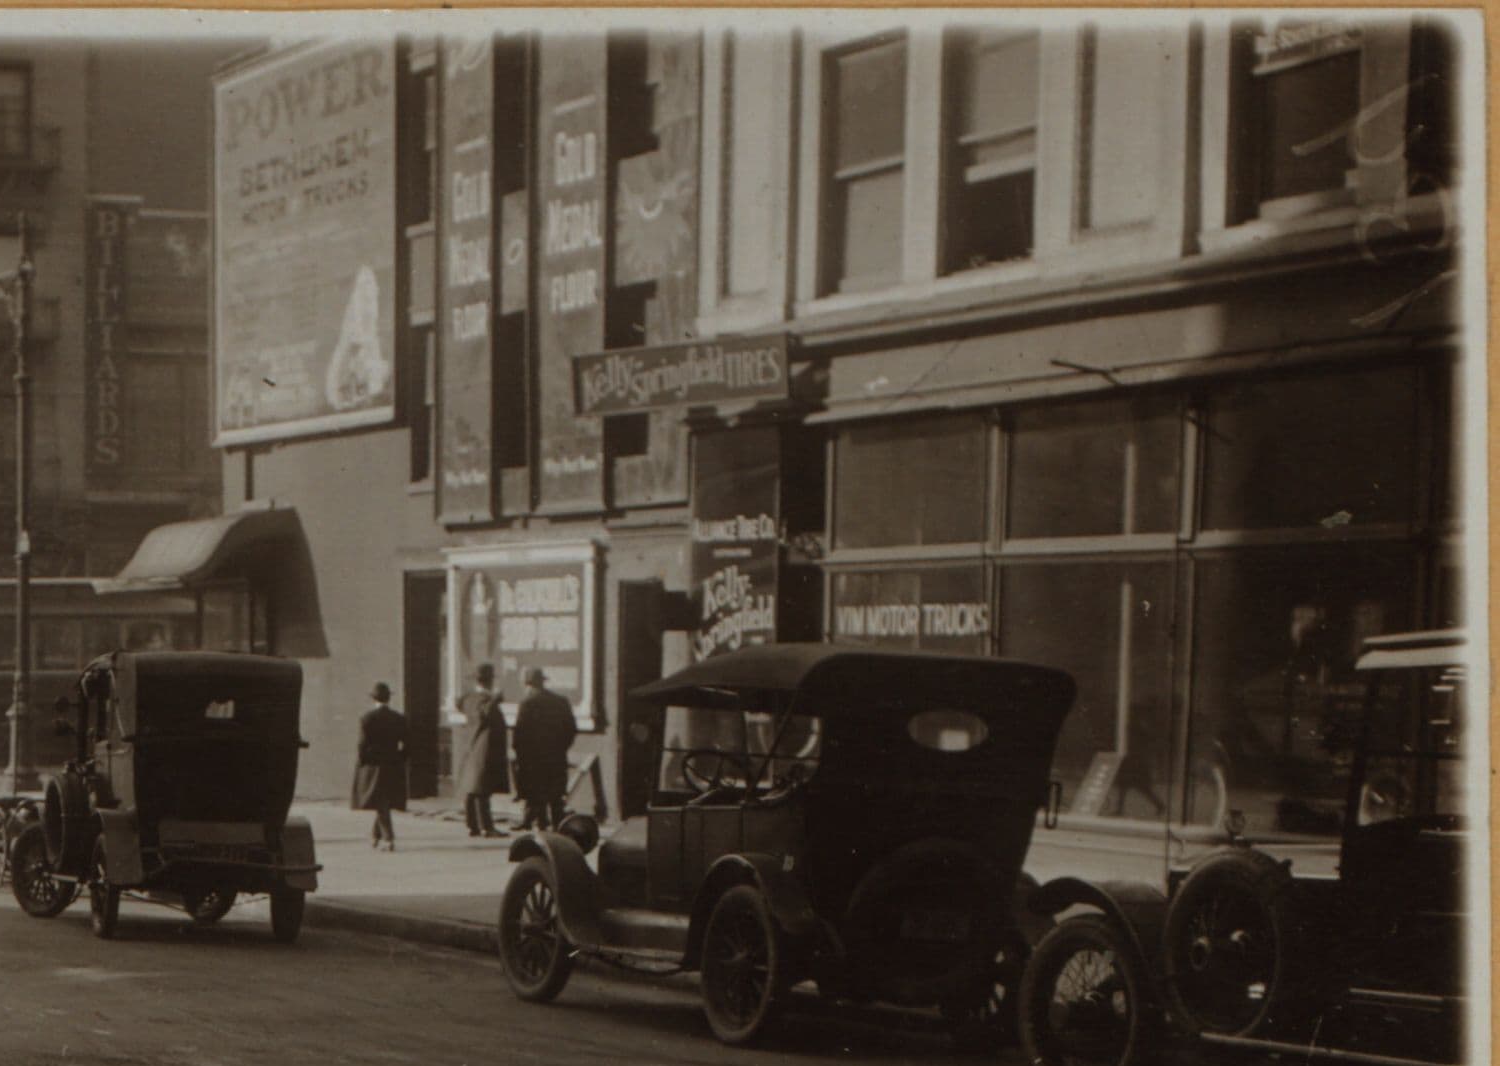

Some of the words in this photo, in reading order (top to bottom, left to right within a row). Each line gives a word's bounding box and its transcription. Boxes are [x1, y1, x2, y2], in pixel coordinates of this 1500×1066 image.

[224, 47, 390, 151] POWER
[239, 127, 371, 198] BETHLEHEM
[554, 130, 597, 187] GOLD
[303, 170, 369, 207] TRUCKS
[547, 198, 602, 257] MEDAL
[551, 268, 598, 316] FLOUR
[97, 209, 120, 464] BILLIARDS
[725, 347, 781, 389] TIRES
[693, 594, 776, 662] Springfield
[867, 604, 920, 636] MOTOR
[922, 602, 989, 636] TRUCKS
